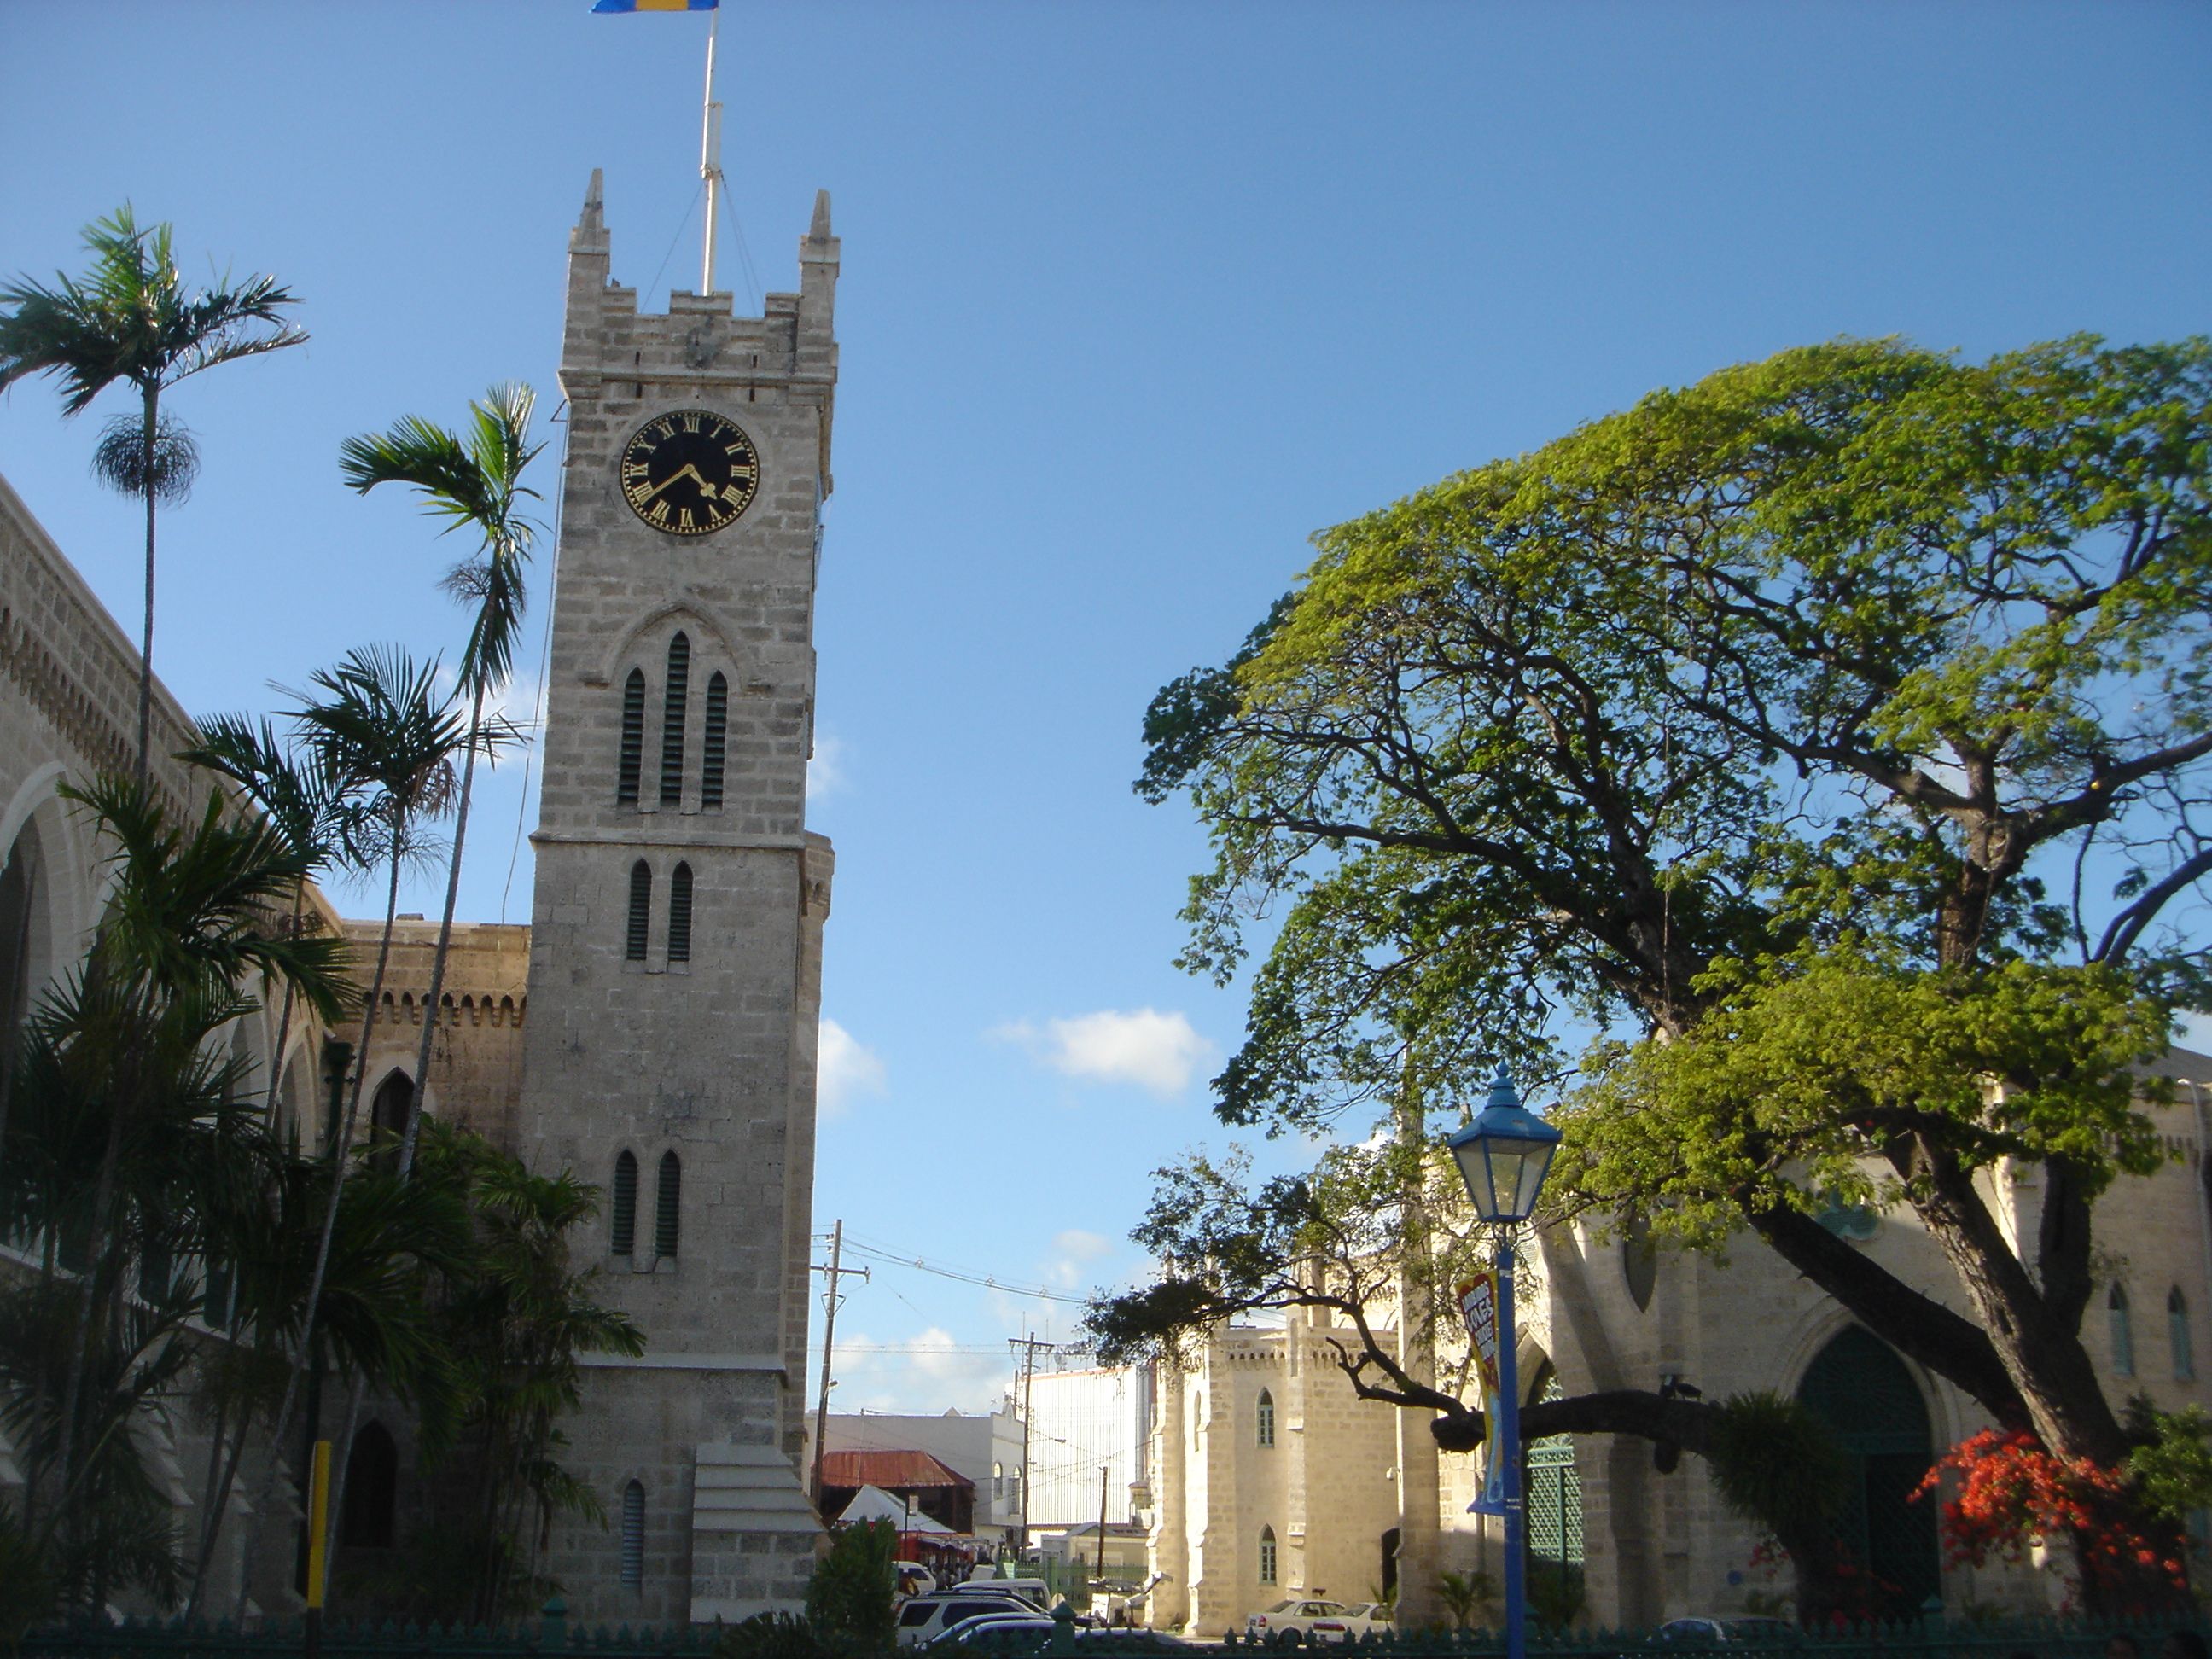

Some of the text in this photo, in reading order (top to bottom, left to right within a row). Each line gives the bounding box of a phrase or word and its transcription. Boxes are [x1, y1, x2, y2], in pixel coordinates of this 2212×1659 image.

[657, 421, 675, 439] XI
[684, 416, 699, 433] XII
[710, 424, 723, 439] I
[637, 439, 656, 454] X
[725, 443, 745, 455] II
[631, 463, 649, 476] IX
[731, 464, 750, 478] III
[721, 484, 745, 507] IIII
[650, 498, 670, 521] VII
[680, 508, 694, 527] VI
[709, 504, 722, 521] V
[1465, 1296, 1493, 1332] LOVES
